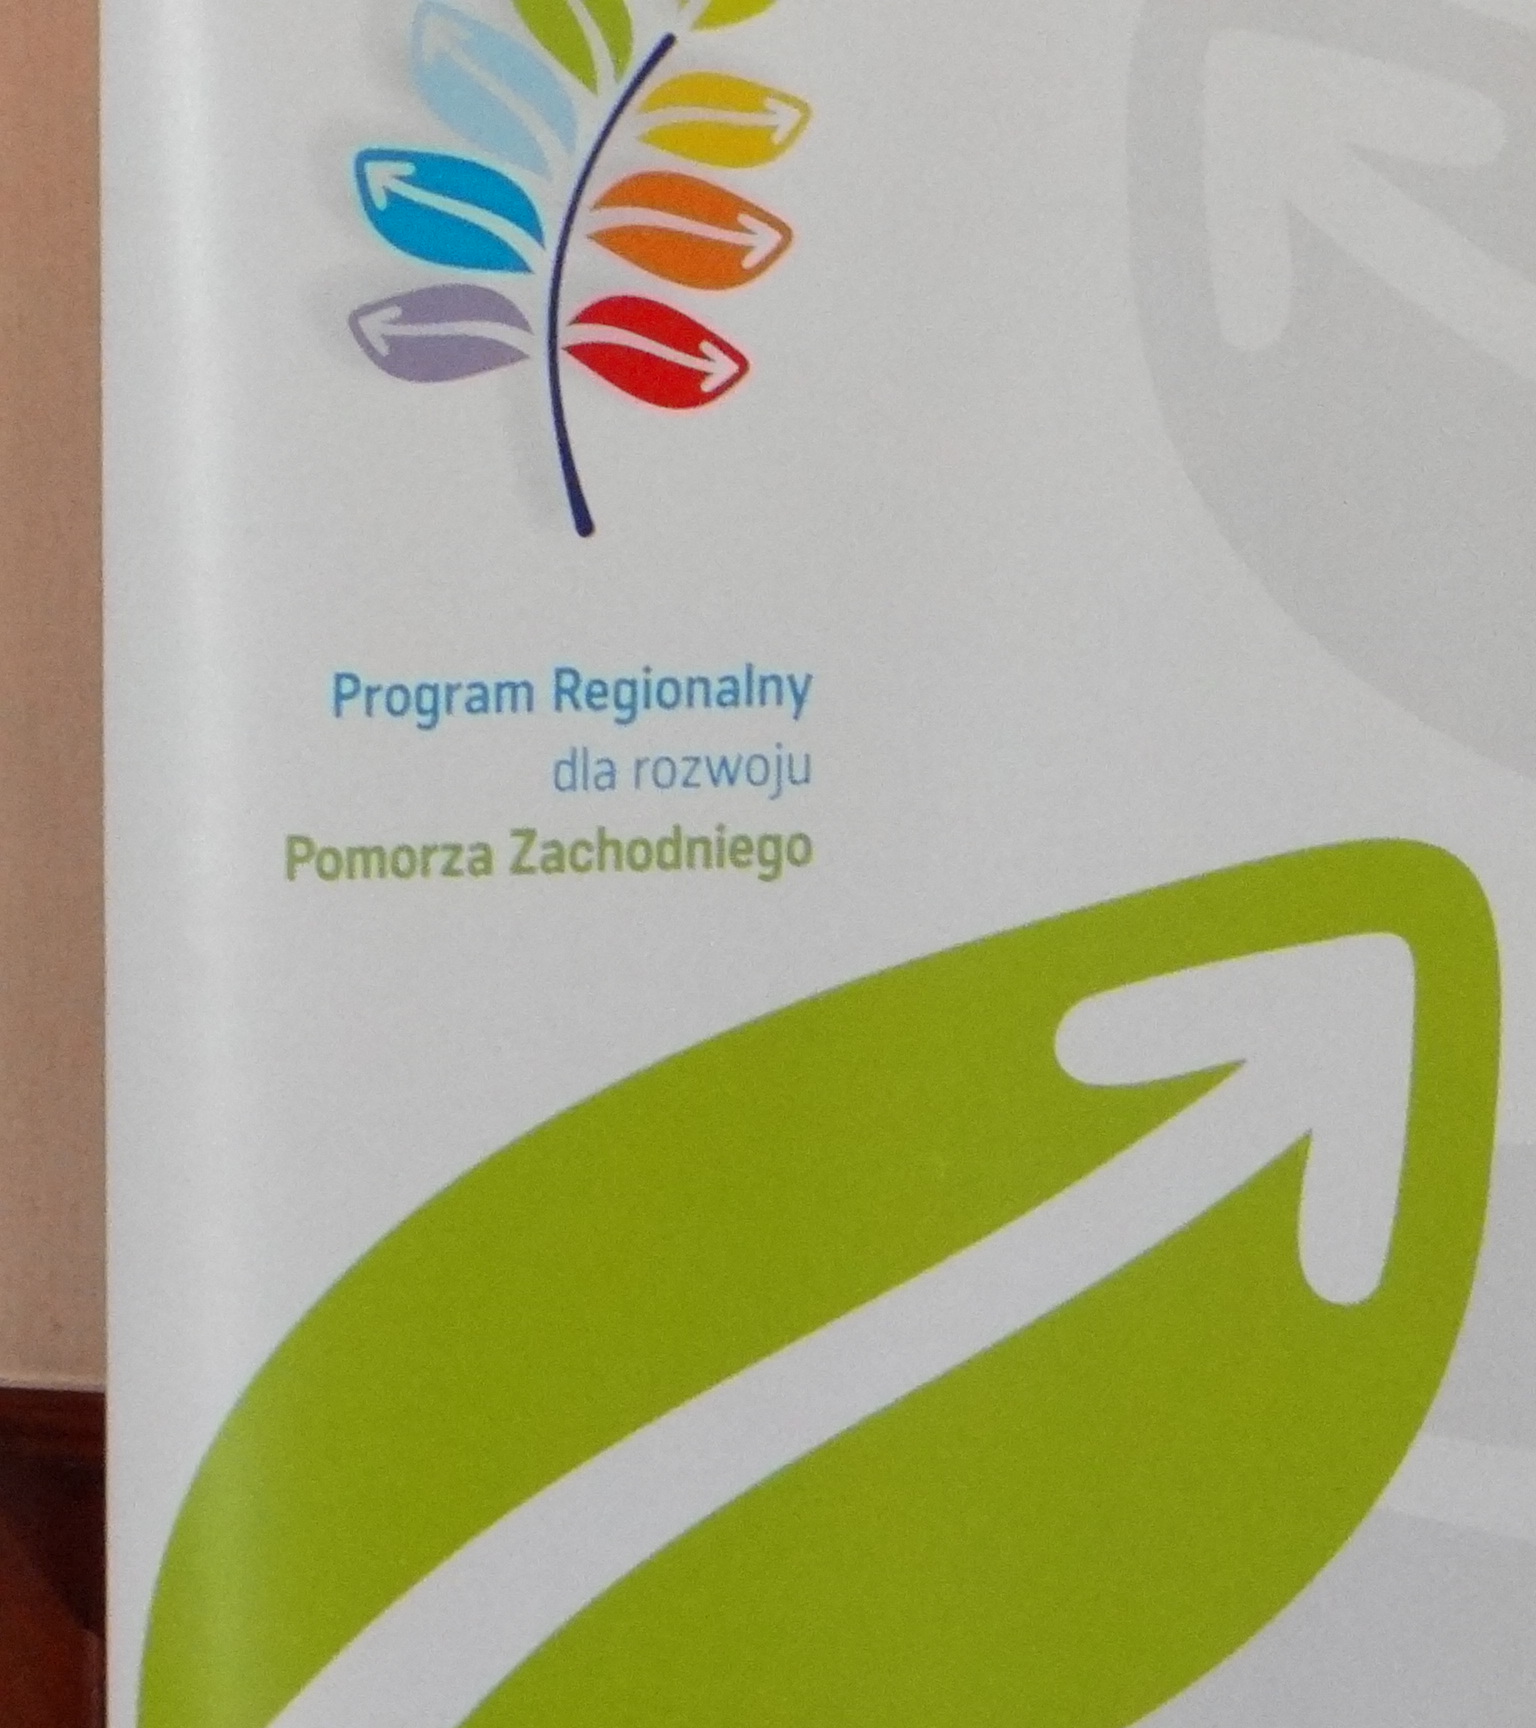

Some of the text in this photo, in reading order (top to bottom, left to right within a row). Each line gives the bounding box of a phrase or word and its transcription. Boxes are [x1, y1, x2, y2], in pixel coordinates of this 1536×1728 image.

[332, 663, 814, 731] Program Regionalny
[553, 743, 812, 800] dla rozwoju
[284, 824, 813, 882] Pomorza Zachodniego
